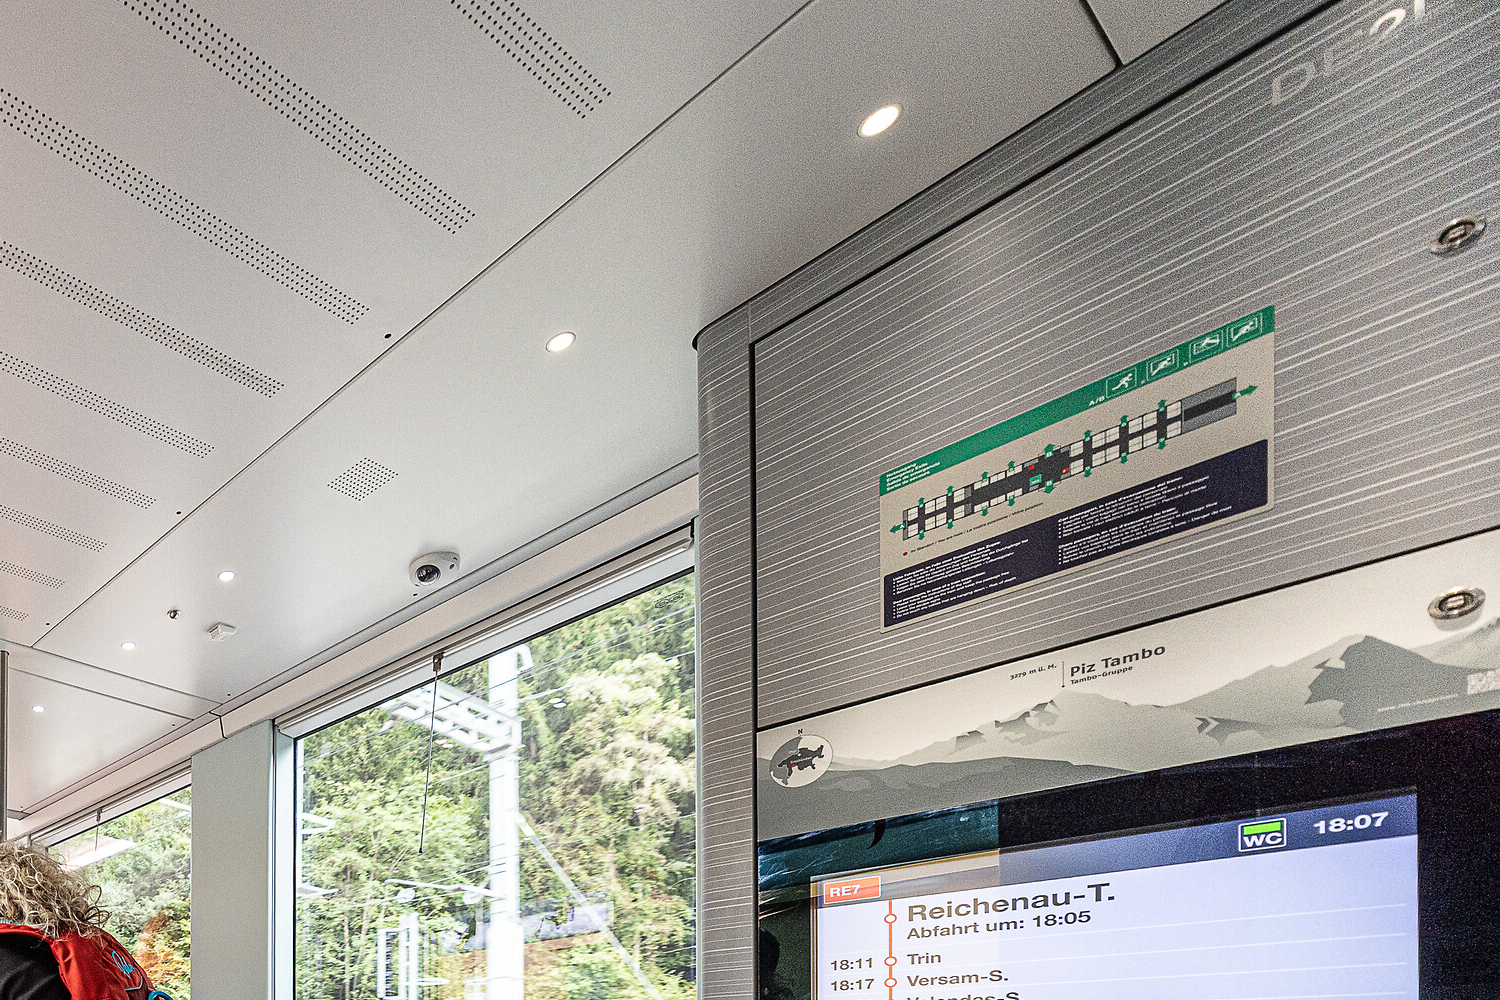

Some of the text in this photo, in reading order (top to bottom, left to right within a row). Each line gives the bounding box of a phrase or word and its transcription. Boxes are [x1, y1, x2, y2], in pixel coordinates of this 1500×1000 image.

[1070, 646, 1166, 677] Piz Tambo
[1070, 665, 1133, 685] Tambo-Gruppe
[1313, 811, 1389, 835] 18:07
[1242, 832, 1283, 848] WC
[829, 884, 861, 898] RE7
[908, 882, 1115, 922] Reichenau-T.
[906, 910, 1092, 940] Abfahrt um: 18:05
[830, 952, 942, 971] 18:11 Trin
[830, 969, 1009, 992] 18:17 Versam-S.
